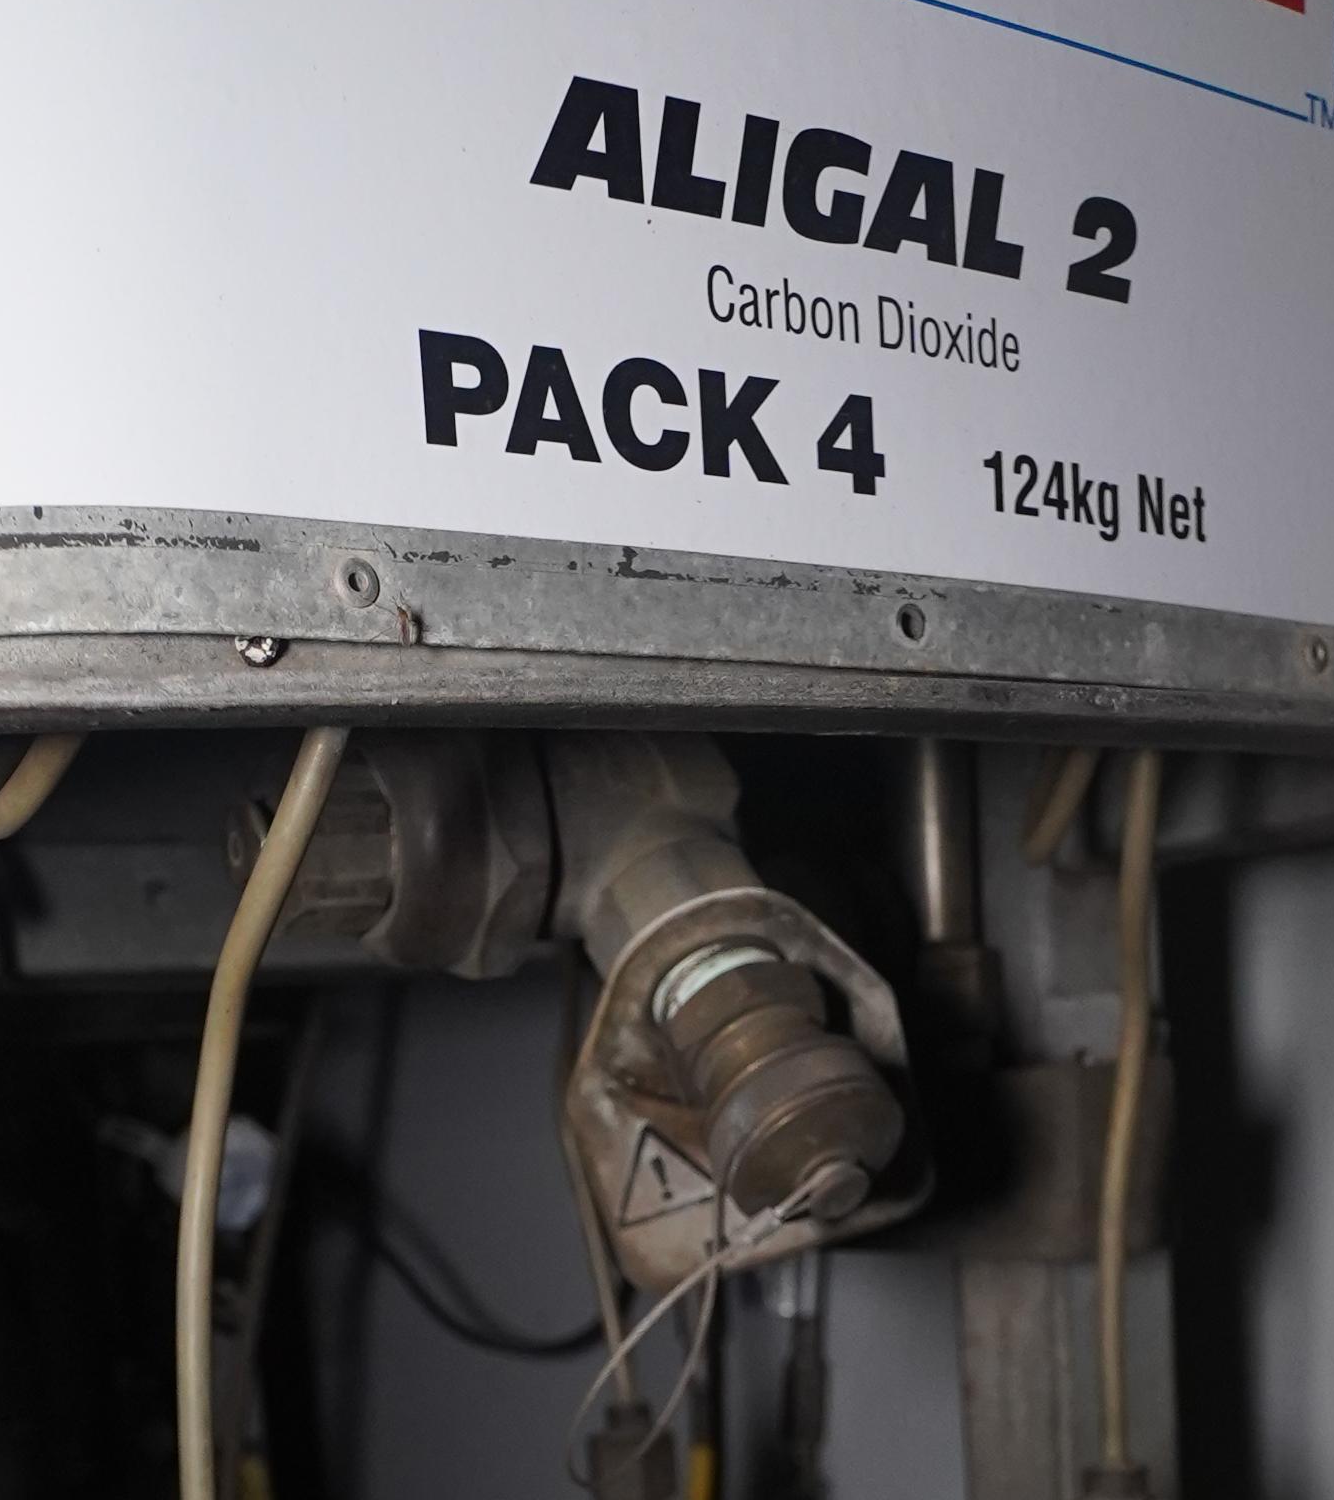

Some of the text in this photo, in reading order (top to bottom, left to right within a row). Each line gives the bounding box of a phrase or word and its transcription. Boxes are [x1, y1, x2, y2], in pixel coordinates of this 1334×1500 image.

[530, 76, 1138, 305] ALIGAL 2
[707, 264, 1021, 373] Carbon Dioxide
[418, 329, 886, 496] PACK 4
[983, 450, 1208, 543] 124kg Net
